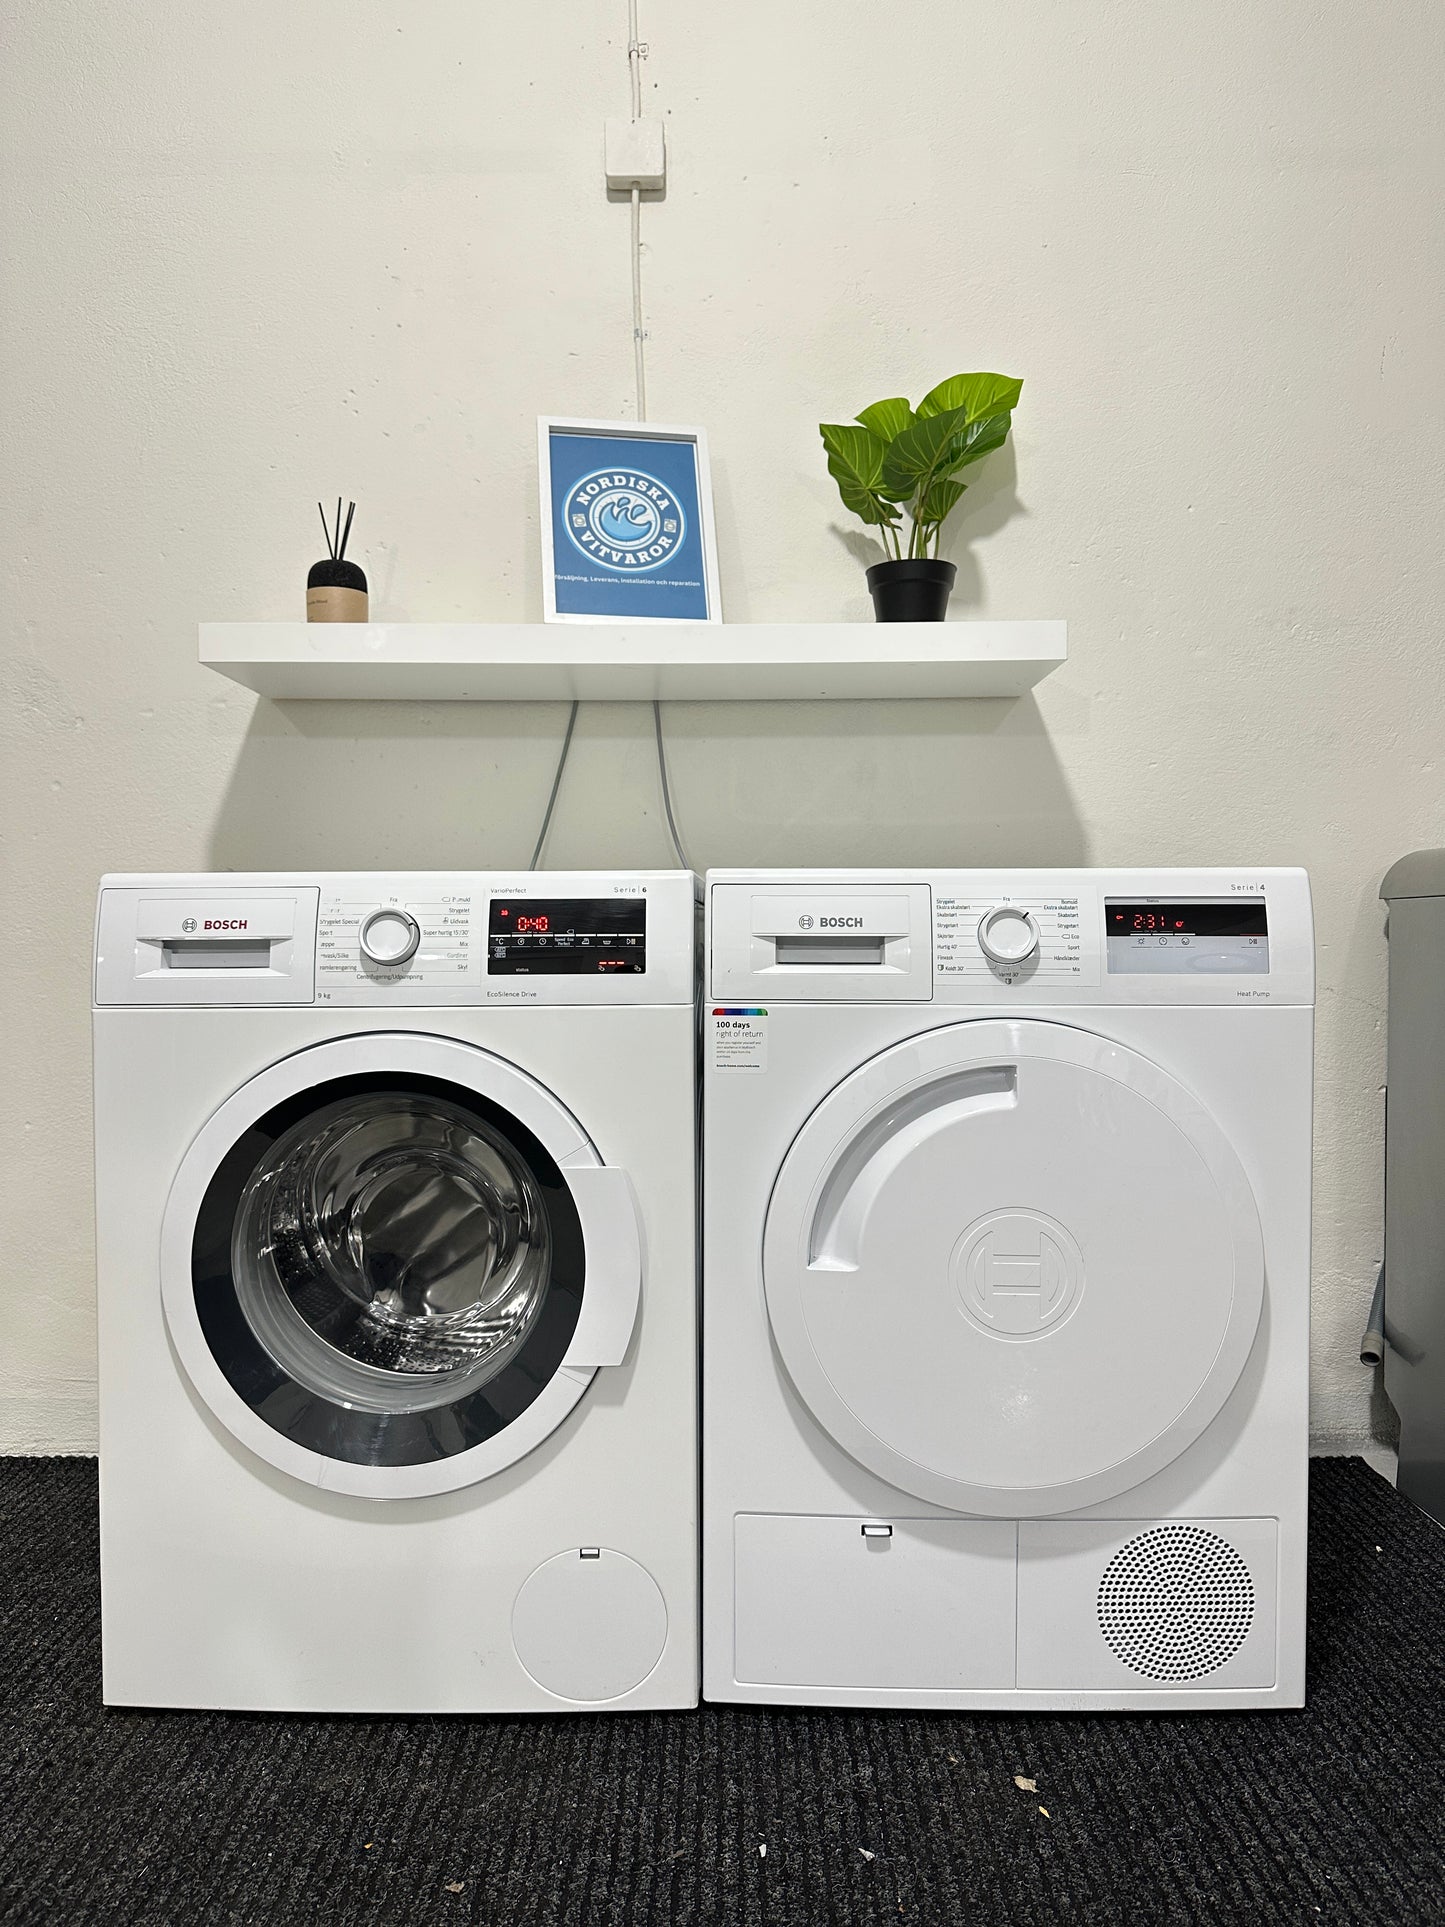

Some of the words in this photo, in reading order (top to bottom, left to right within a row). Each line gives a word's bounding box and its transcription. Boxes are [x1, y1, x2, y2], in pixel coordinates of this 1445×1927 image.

[576, 475, 671, 511] NORDISKA
[581, 530, 673, 564] VITVAROR
[669, 580, 700, 588] reparation
[204, 919, 248, 930] BOSCH
[518, 916, 548, 931] 0:40
[820, 917, 863, 928] BOSCH
[1134, 914, 1165, 929] 2:31
[323, 992, 331, 1000] kg
[732, 1021, 750, 1030] days
[716, 1030, 732, 1038] right
